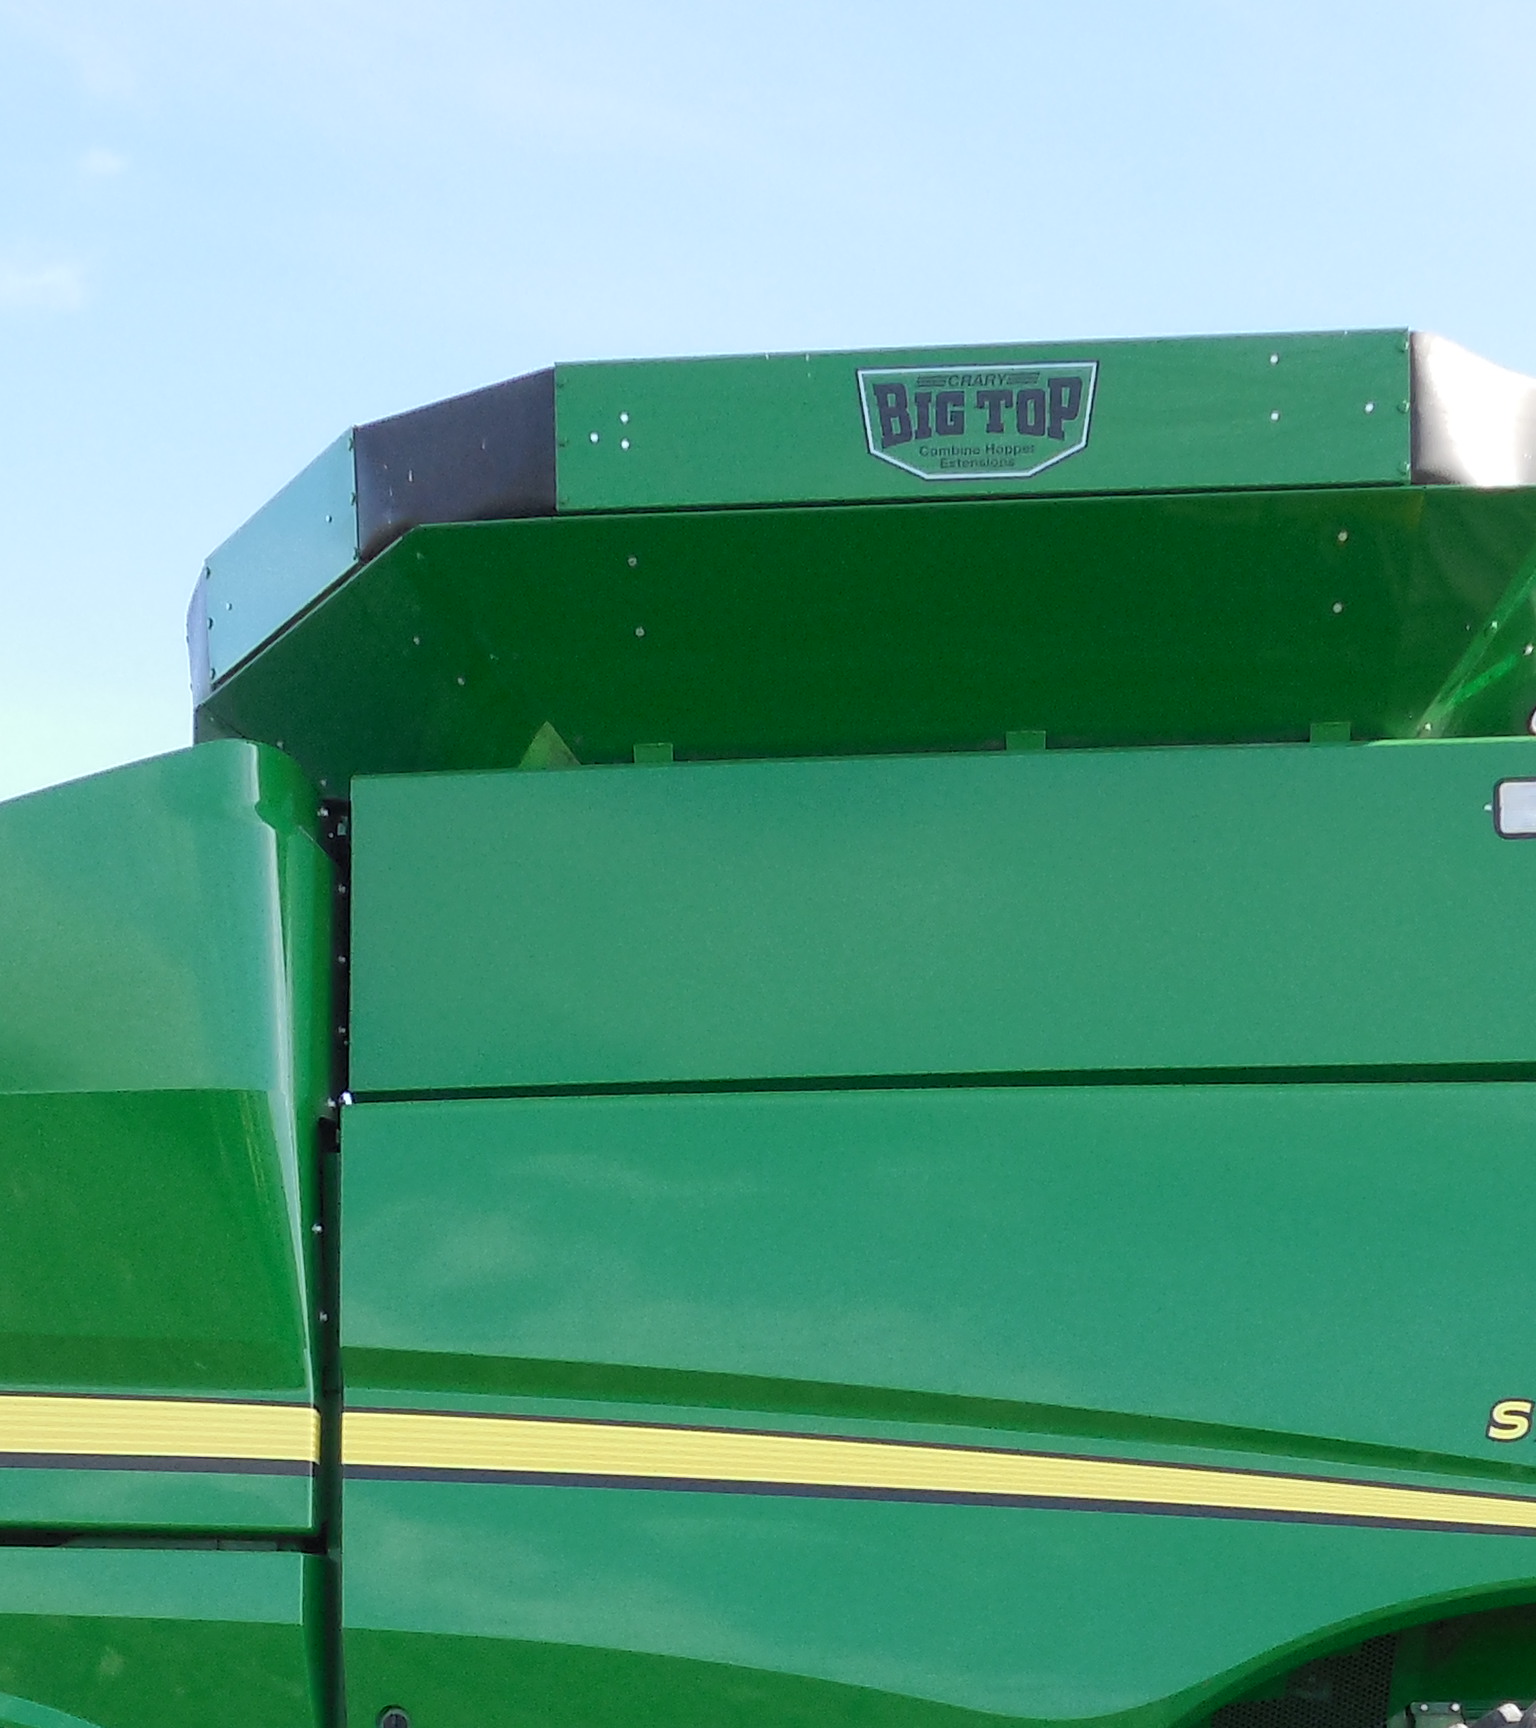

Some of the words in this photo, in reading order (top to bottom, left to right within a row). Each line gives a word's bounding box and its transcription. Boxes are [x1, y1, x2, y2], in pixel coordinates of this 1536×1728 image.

[946, 373, 1007, 387] CRARY
[873, 382, 966, 448] BIG
[974, 376, 1083, 440] TOP
[919, 444, 980, 457] Combine
[985, 442, 1035, 456] Hopper
[940, 456, 1015, 469] Extensions
